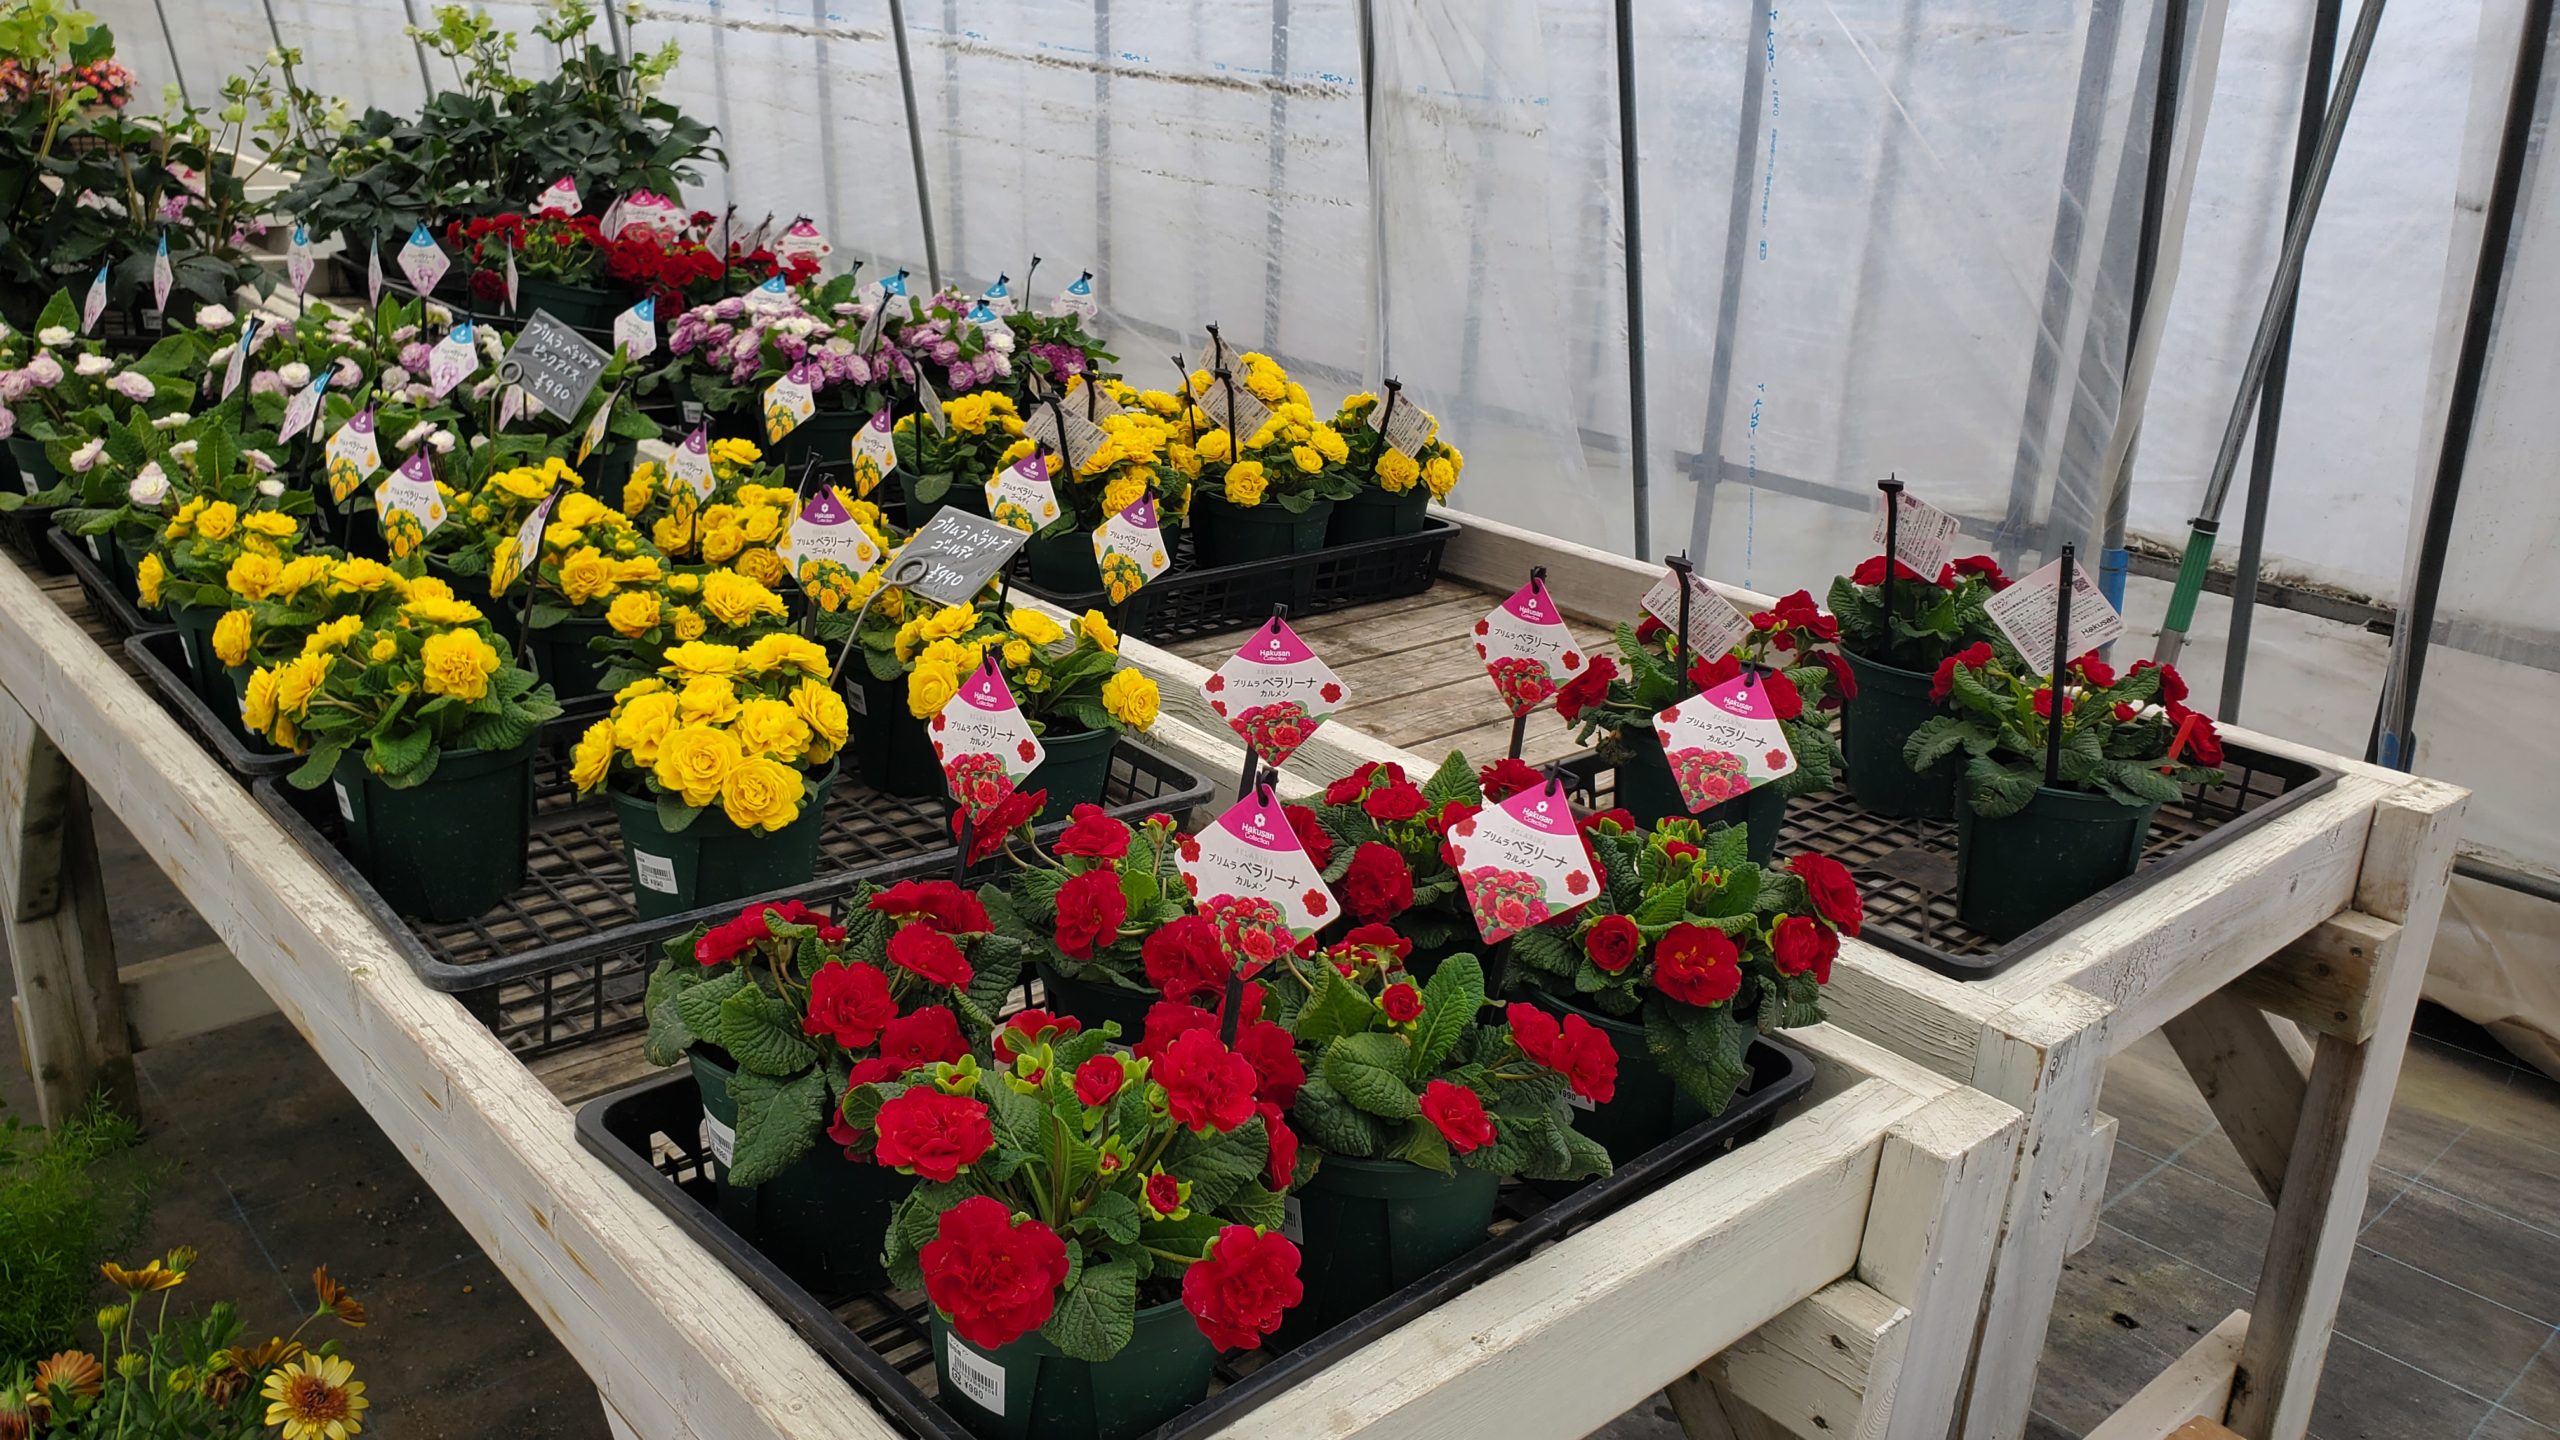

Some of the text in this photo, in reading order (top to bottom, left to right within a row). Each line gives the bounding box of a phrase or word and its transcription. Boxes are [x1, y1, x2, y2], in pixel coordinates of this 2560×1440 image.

[534, 371, 570, 399] ¥990
[932, 517, 1014, 551] プリムラ ベラリーナ
[796, 537, 854, 548] プリムラ ベラリーナ
[930, 539, 974, 559] ゴールディ
[1124, 535, 1153, 551] ベラリーナ
[811, 547, 837, 556] ゴールディ
[924, 563, 964, 586] ¥990
[1519, 605, 1544, 618] Hakusan
[2081, 615, 2117, 635] Hakusan
[1494, 628, 1515, 640] プリムラ
[1517, 633, 1560, 652] ベラリーナ
[1259, 649, 1290, 658] Hakusan
[1513, 643, 1537, 655] カルメン
[1233, 677, 1317, 689] プリムラ ベラリーナ
[974, 692, 997, 703] Hakusan
[1260, 690, 1289, 698] カルメン
[1723, 696, 1753, 712] Hakusan
[1725, 703, 1748, 715] Collection
[951, 721, 1015, 742] プリムラ ベラリーナ
[1685, 716, 1767, 748] プリムラ ベラリーナ
[969, 737, 993, 748] カルメン
[1707, 734, 1736, 748] カルメン
[1522, 807, 1554, 825] Hakusan
[1524, 815, 1548, 829] Collection
[1241, 822, 1275, 841] Hakusan
[1244, 832, 1270, 846] Collection
[1481, 830, 1568, 869] プリムラ ベラリーナ
[1503, 851, 1534, 868] カルメン
[1208, 853, 1300, 890] プリムラ ベラリーナ
[1235, 875, 1267, 892] カルメン
